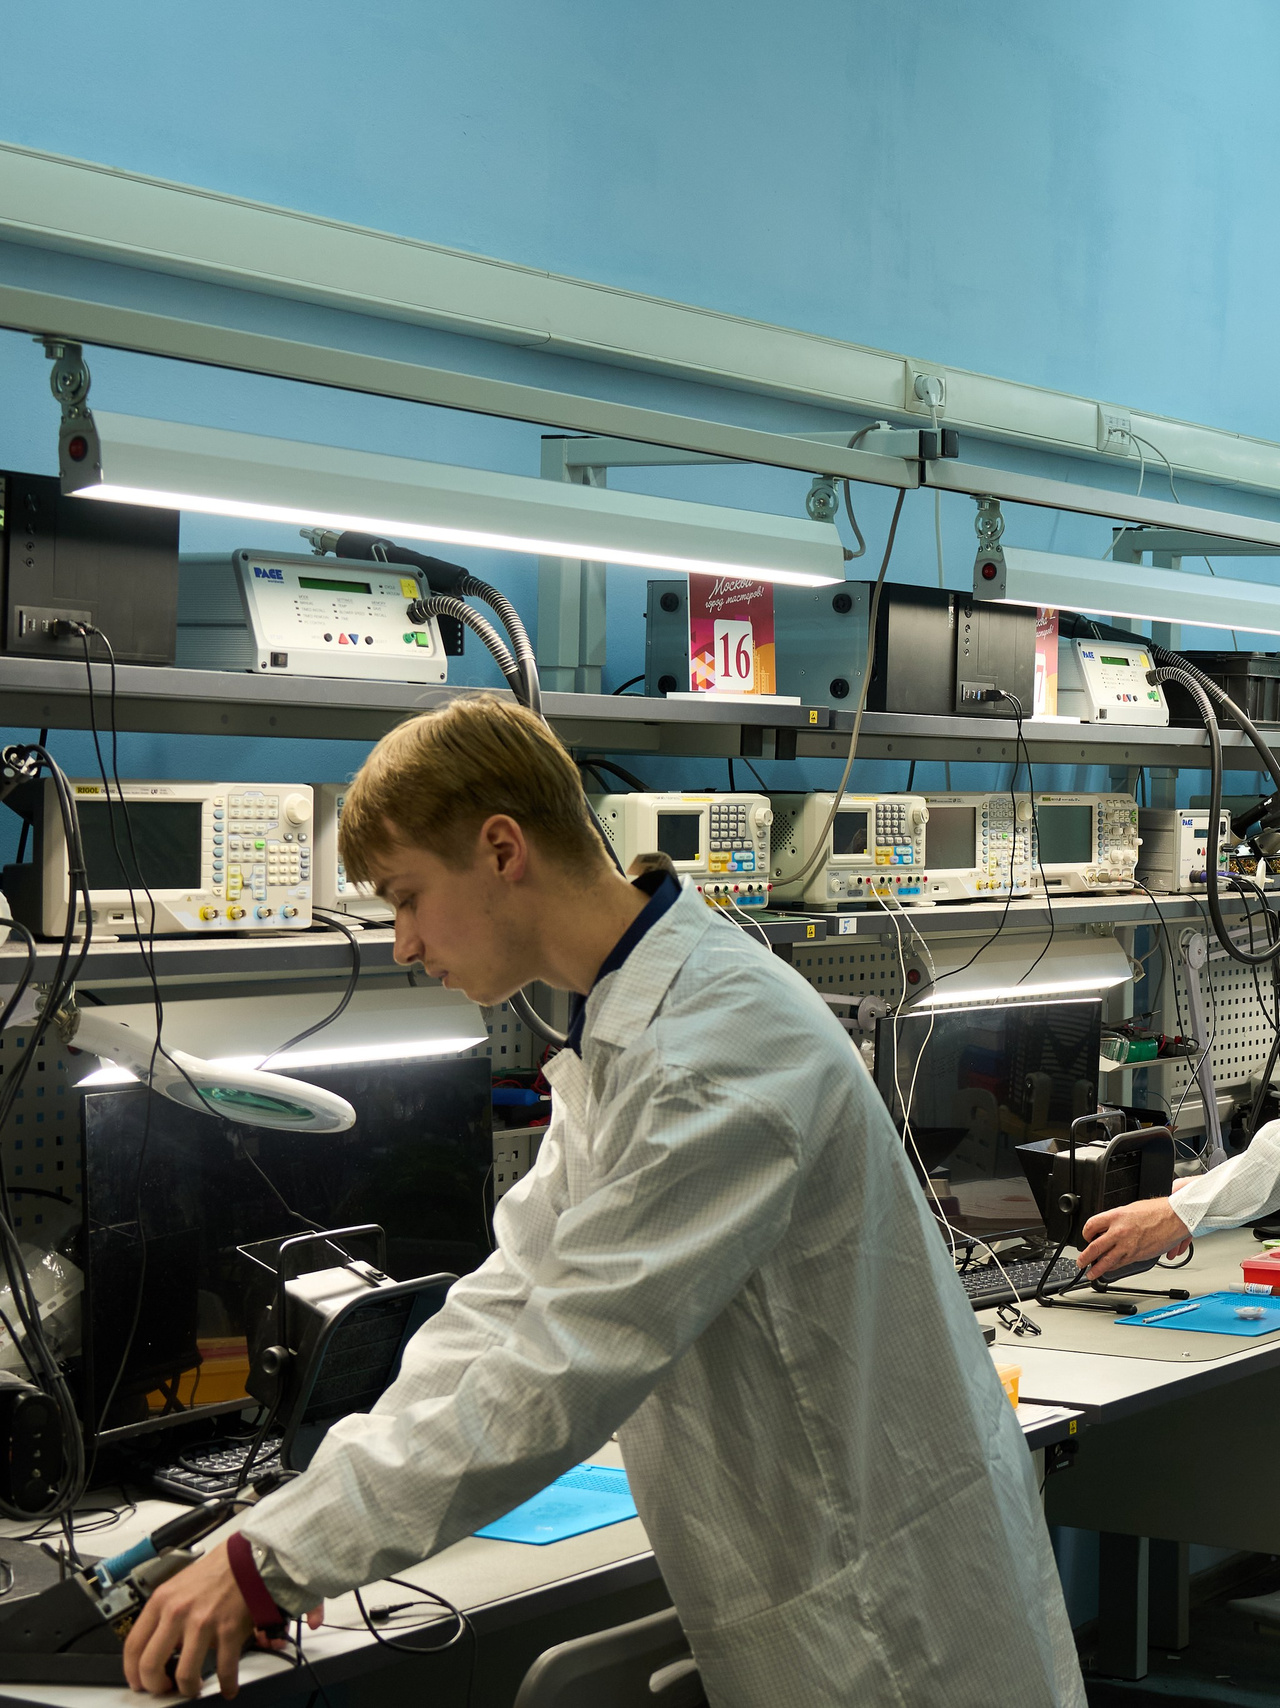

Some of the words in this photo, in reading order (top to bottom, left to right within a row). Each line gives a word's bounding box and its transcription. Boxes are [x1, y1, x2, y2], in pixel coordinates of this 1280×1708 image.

[253, 567, 284, 580] PACE
[726, 586, 765, 605] мастеров!
[719, 632, 751, 679] 16
[1082, 651, 1095, 659] PACE
[842, 920, 850, 933] 5
